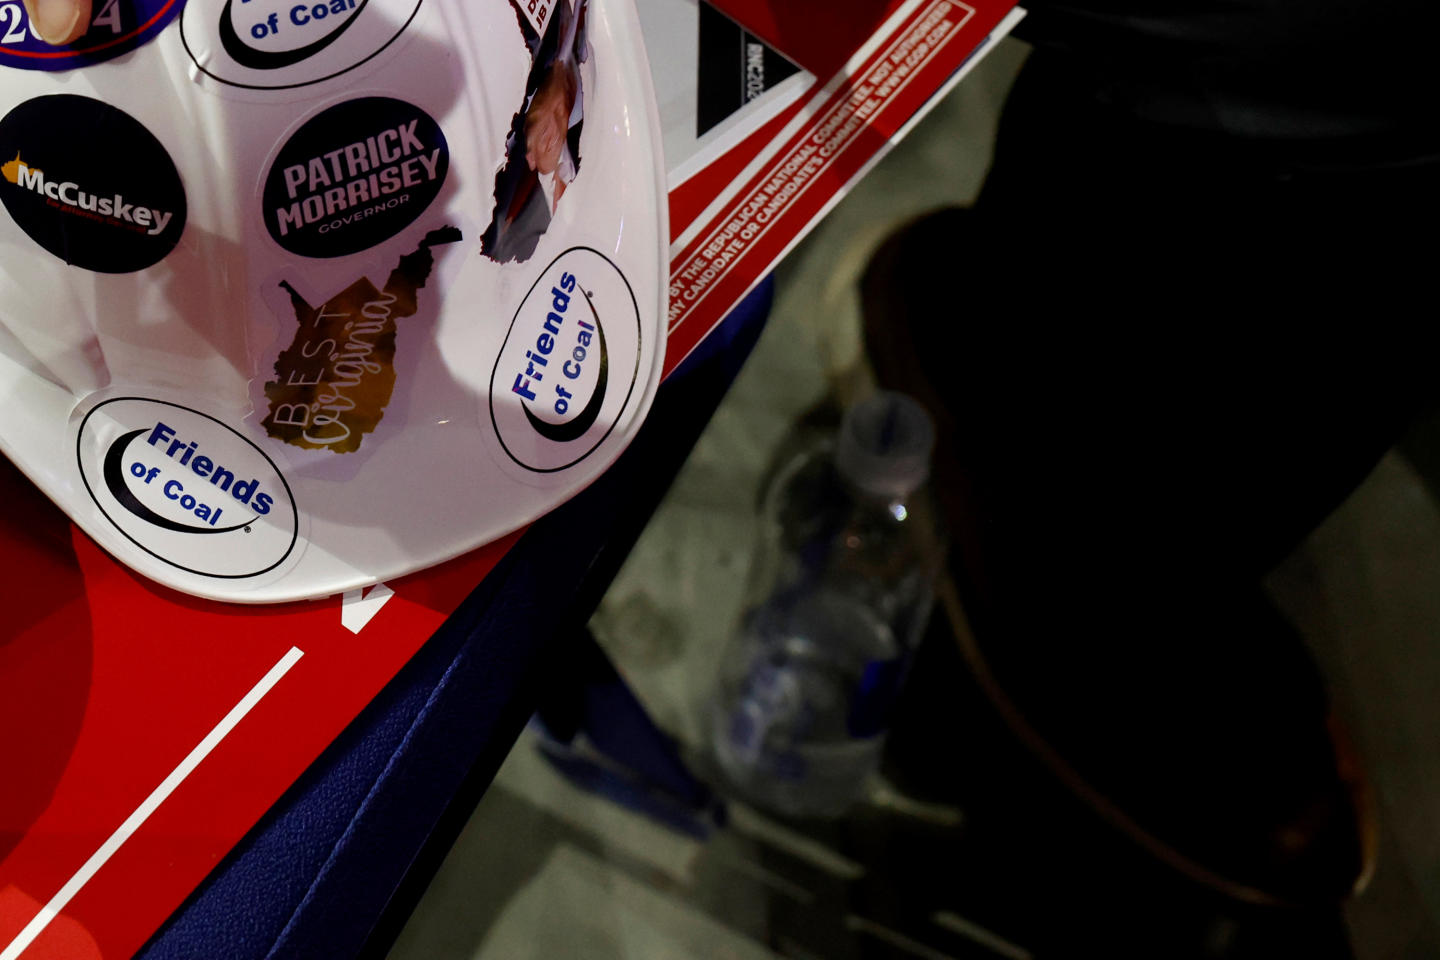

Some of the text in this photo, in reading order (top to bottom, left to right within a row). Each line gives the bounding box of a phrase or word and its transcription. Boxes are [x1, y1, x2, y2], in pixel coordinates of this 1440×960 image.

[250, 12, 279, 40] of
[536, 5, 548, 29] JB
[747, 42, 765, 99] RNC202
[282, 117, 425, 200] PATRICK
[681, 257, 708, 281] THE
[702, 193, 765, 260] REPUBLICAN
[763, 142, 817, 198] NATIONAL
[868, 60, 895, 86] NOT
[890, 0, 953, 64] AUTHORIZED
[683, 242, 741, 301] CANDIDATE
[740, 221, 760, 240] OR
[756, 155, 824, 224] CANDIDATE'S
[874, 18, 955, 99] WWW.GOP.COM
[16, 163, 174, 236] McCuskey
[275, 147, 441, 238] MORRISEY
[317, 193, 410, 235] GOVERNOR
[273, 304, 352, 427] BEST
[301, 291, 398, 444] Virginia
[512, 271, 577, 402] Friends
[554, 320, 595, 415] of Coal
[130, 462, 224, 526] of Coal
[147, 422, 274, 516] Friends
